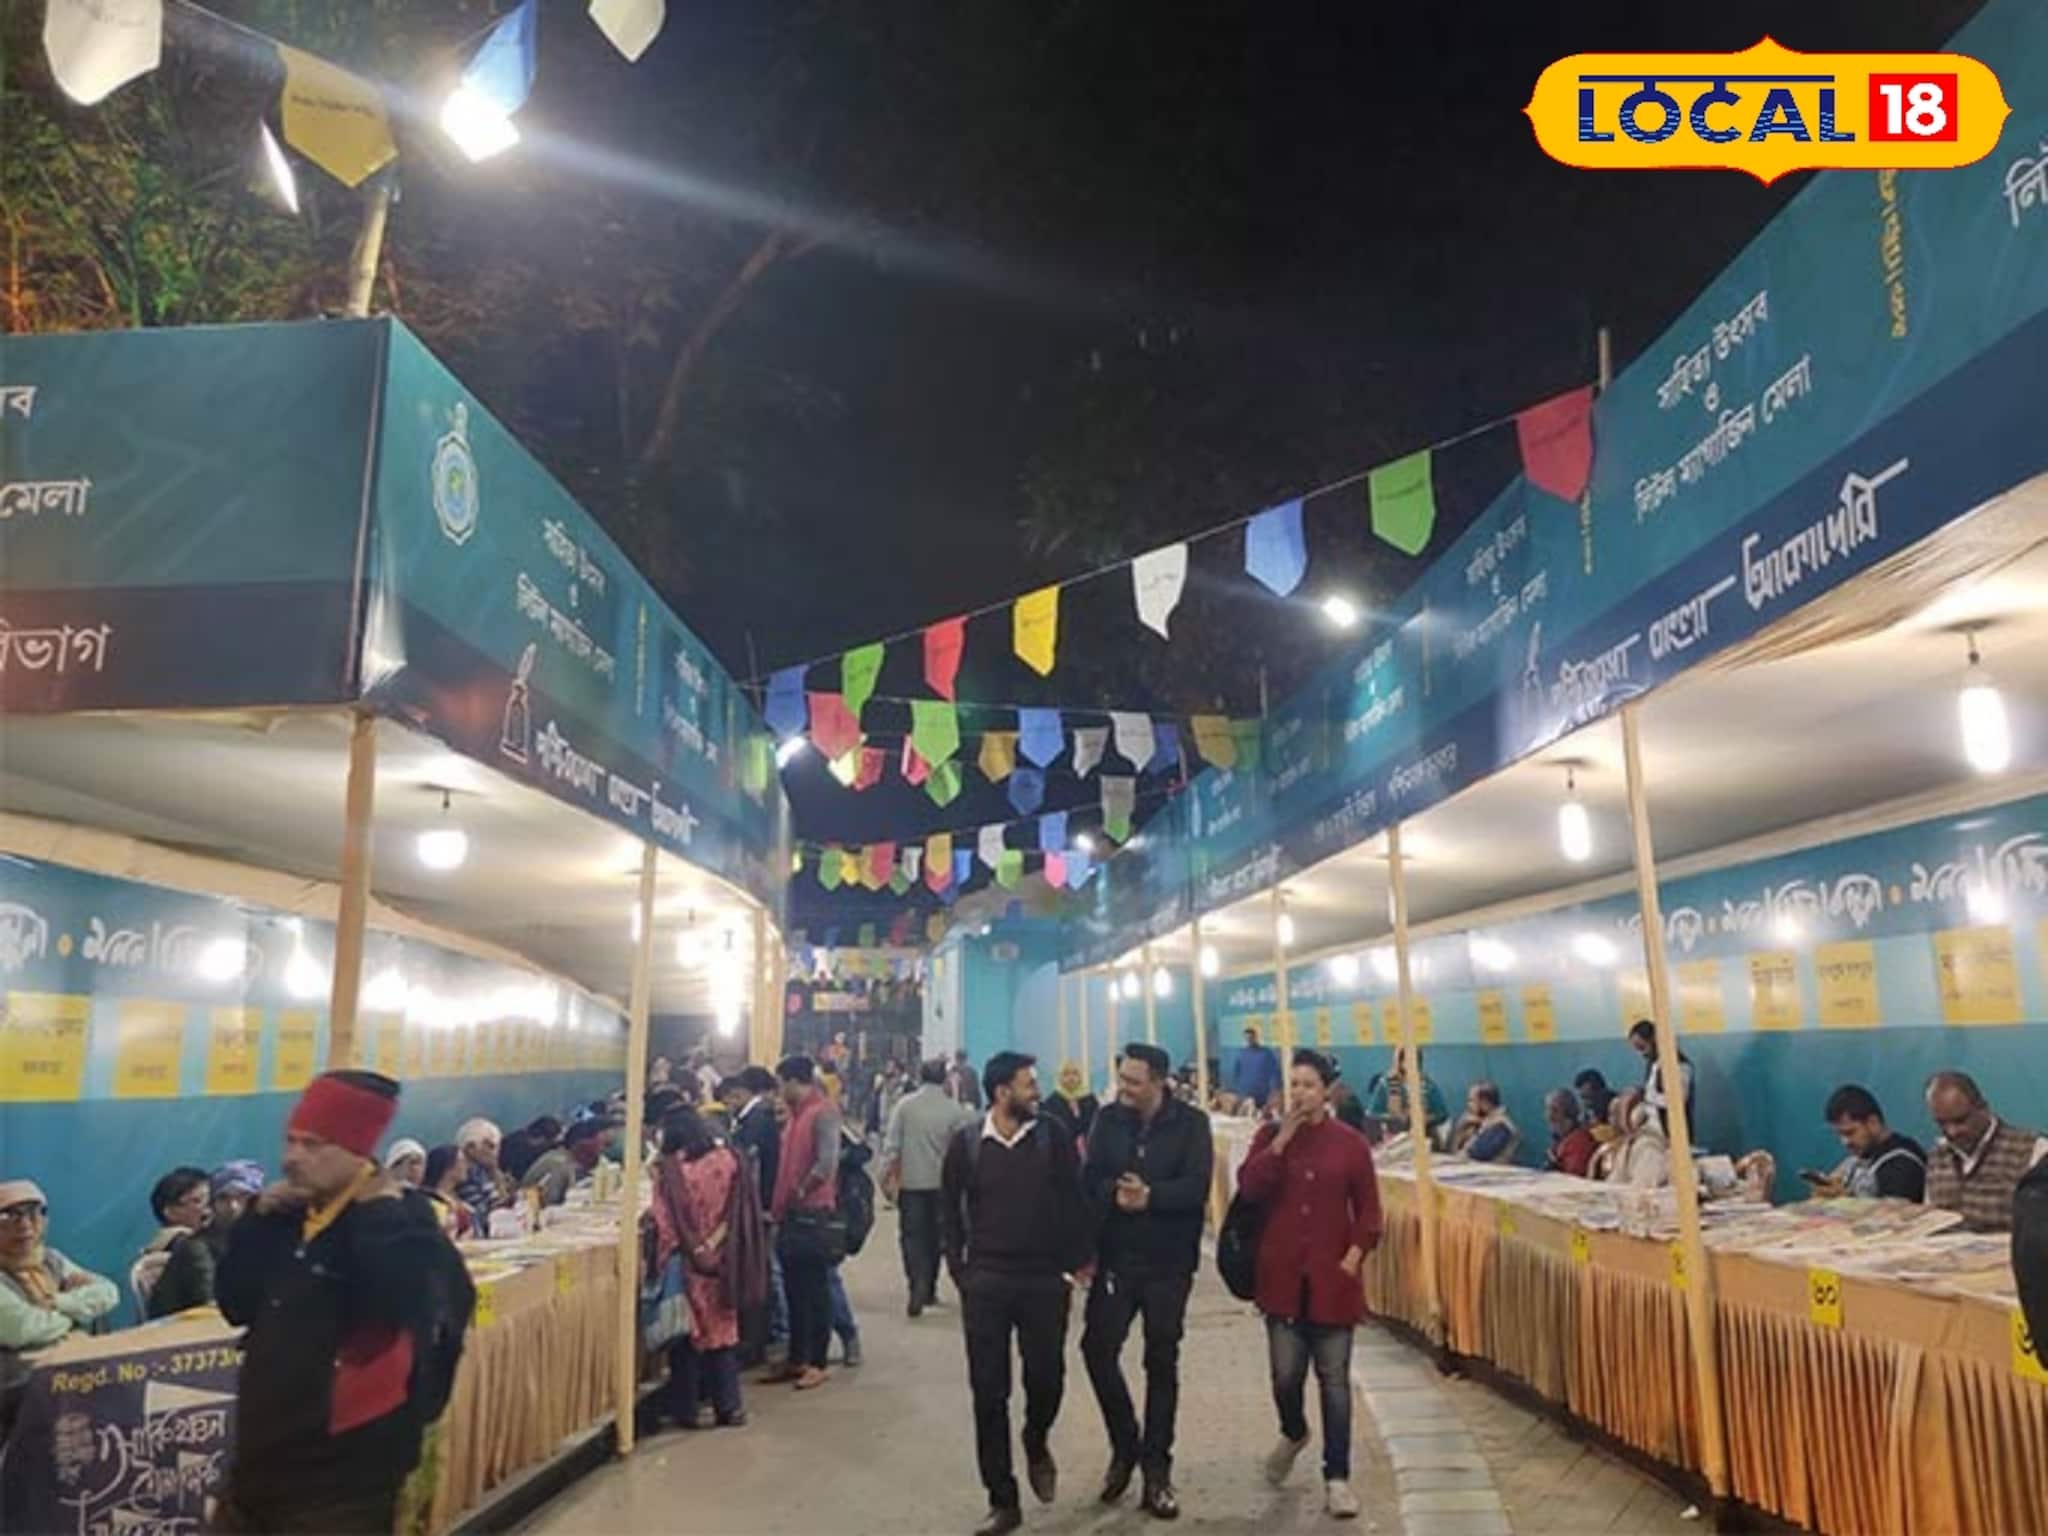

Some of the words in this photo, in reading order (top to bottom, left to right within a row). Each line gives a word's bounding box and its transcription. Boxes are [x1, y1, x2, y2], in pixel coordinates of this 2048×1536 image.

[1656, 343, 1711, 410] সাহিত্য
[1712, 288, 1768, 360] উৎসব
[1703, 380, 1721, 412] ও
[1760, 351, 1811, 424] মেলা
[0, 475, 92, 518] মেলা
[118, 1363, 146, 1383] No
